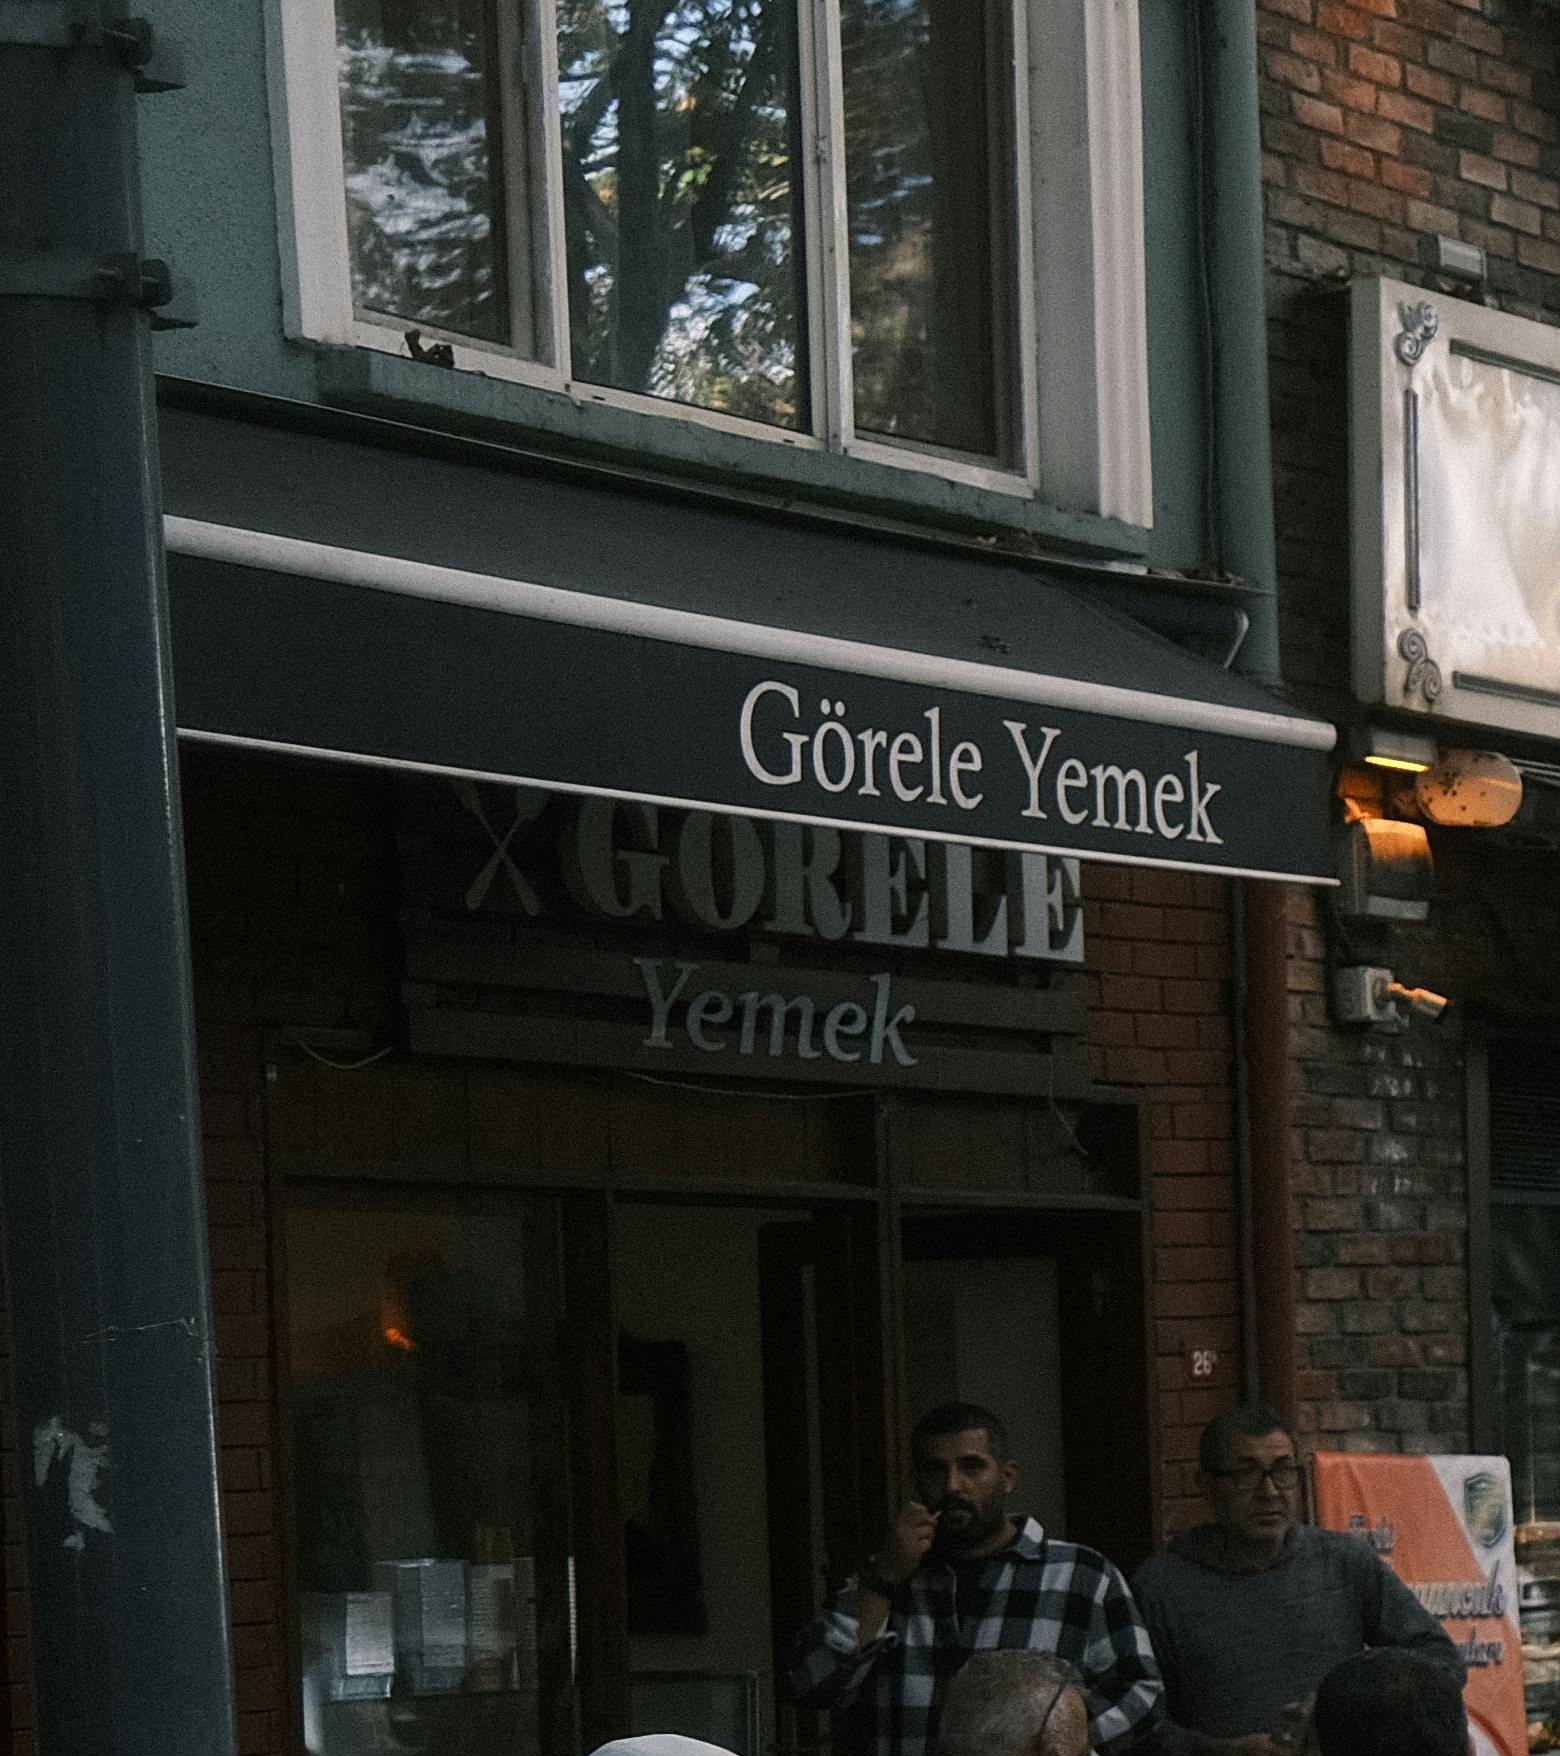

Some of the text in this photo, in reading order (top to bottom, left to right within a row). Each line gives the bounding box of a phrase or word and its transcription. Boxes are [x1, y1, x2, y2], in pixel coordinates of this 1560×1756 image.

[740, 680, 1225, 845] Görele Yemek
[632, 957, 919, 1068] Yemek
